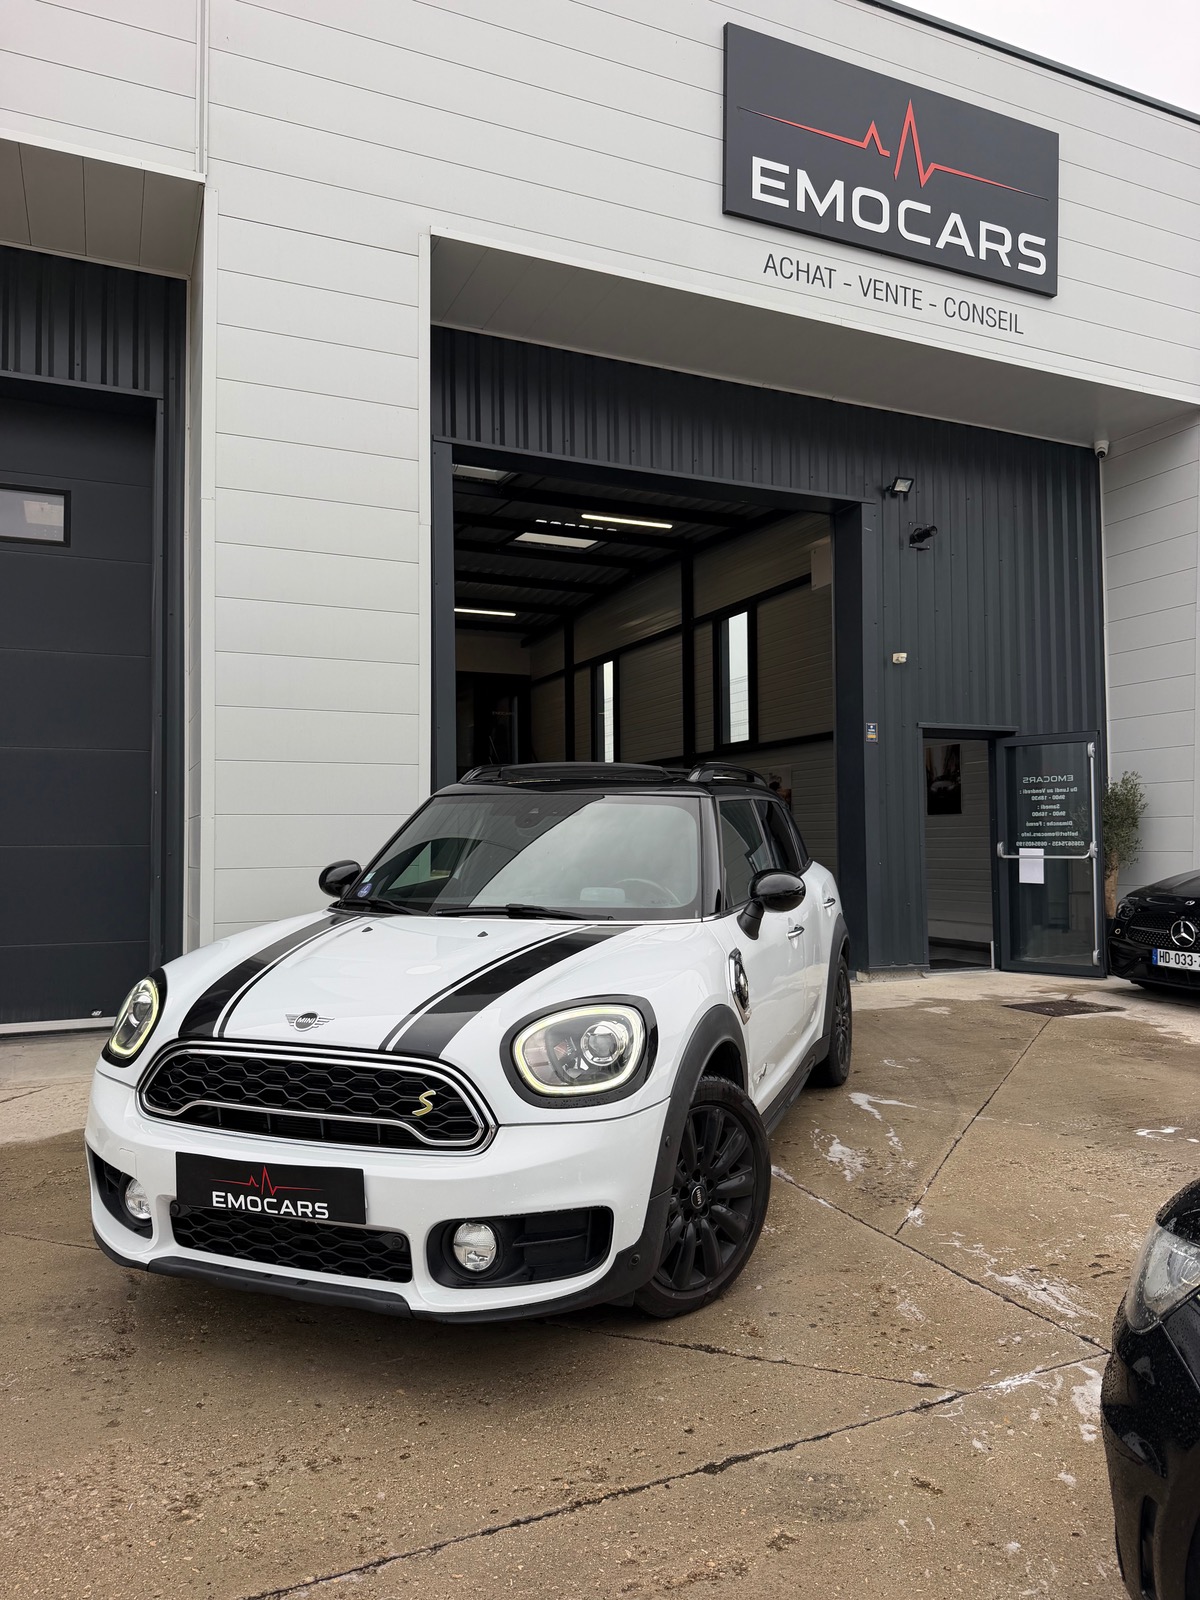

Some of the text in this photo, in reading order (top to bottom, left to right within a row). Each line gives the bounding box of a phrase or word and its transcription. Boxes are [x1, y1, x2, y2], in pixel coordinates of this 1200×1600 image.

[752, 156, 1046, 275] EMOCARS
[763, 253, 836, 289] ACHAT
[858, 275, 923, 311] VENTE
[944, 296, 1025, 335] CONSEIL
[1159, 950, 1200, 968] HD-033-
[412, 1090, 436, 1116] S
[212, 1191, 329, 1219] EMOCARS
